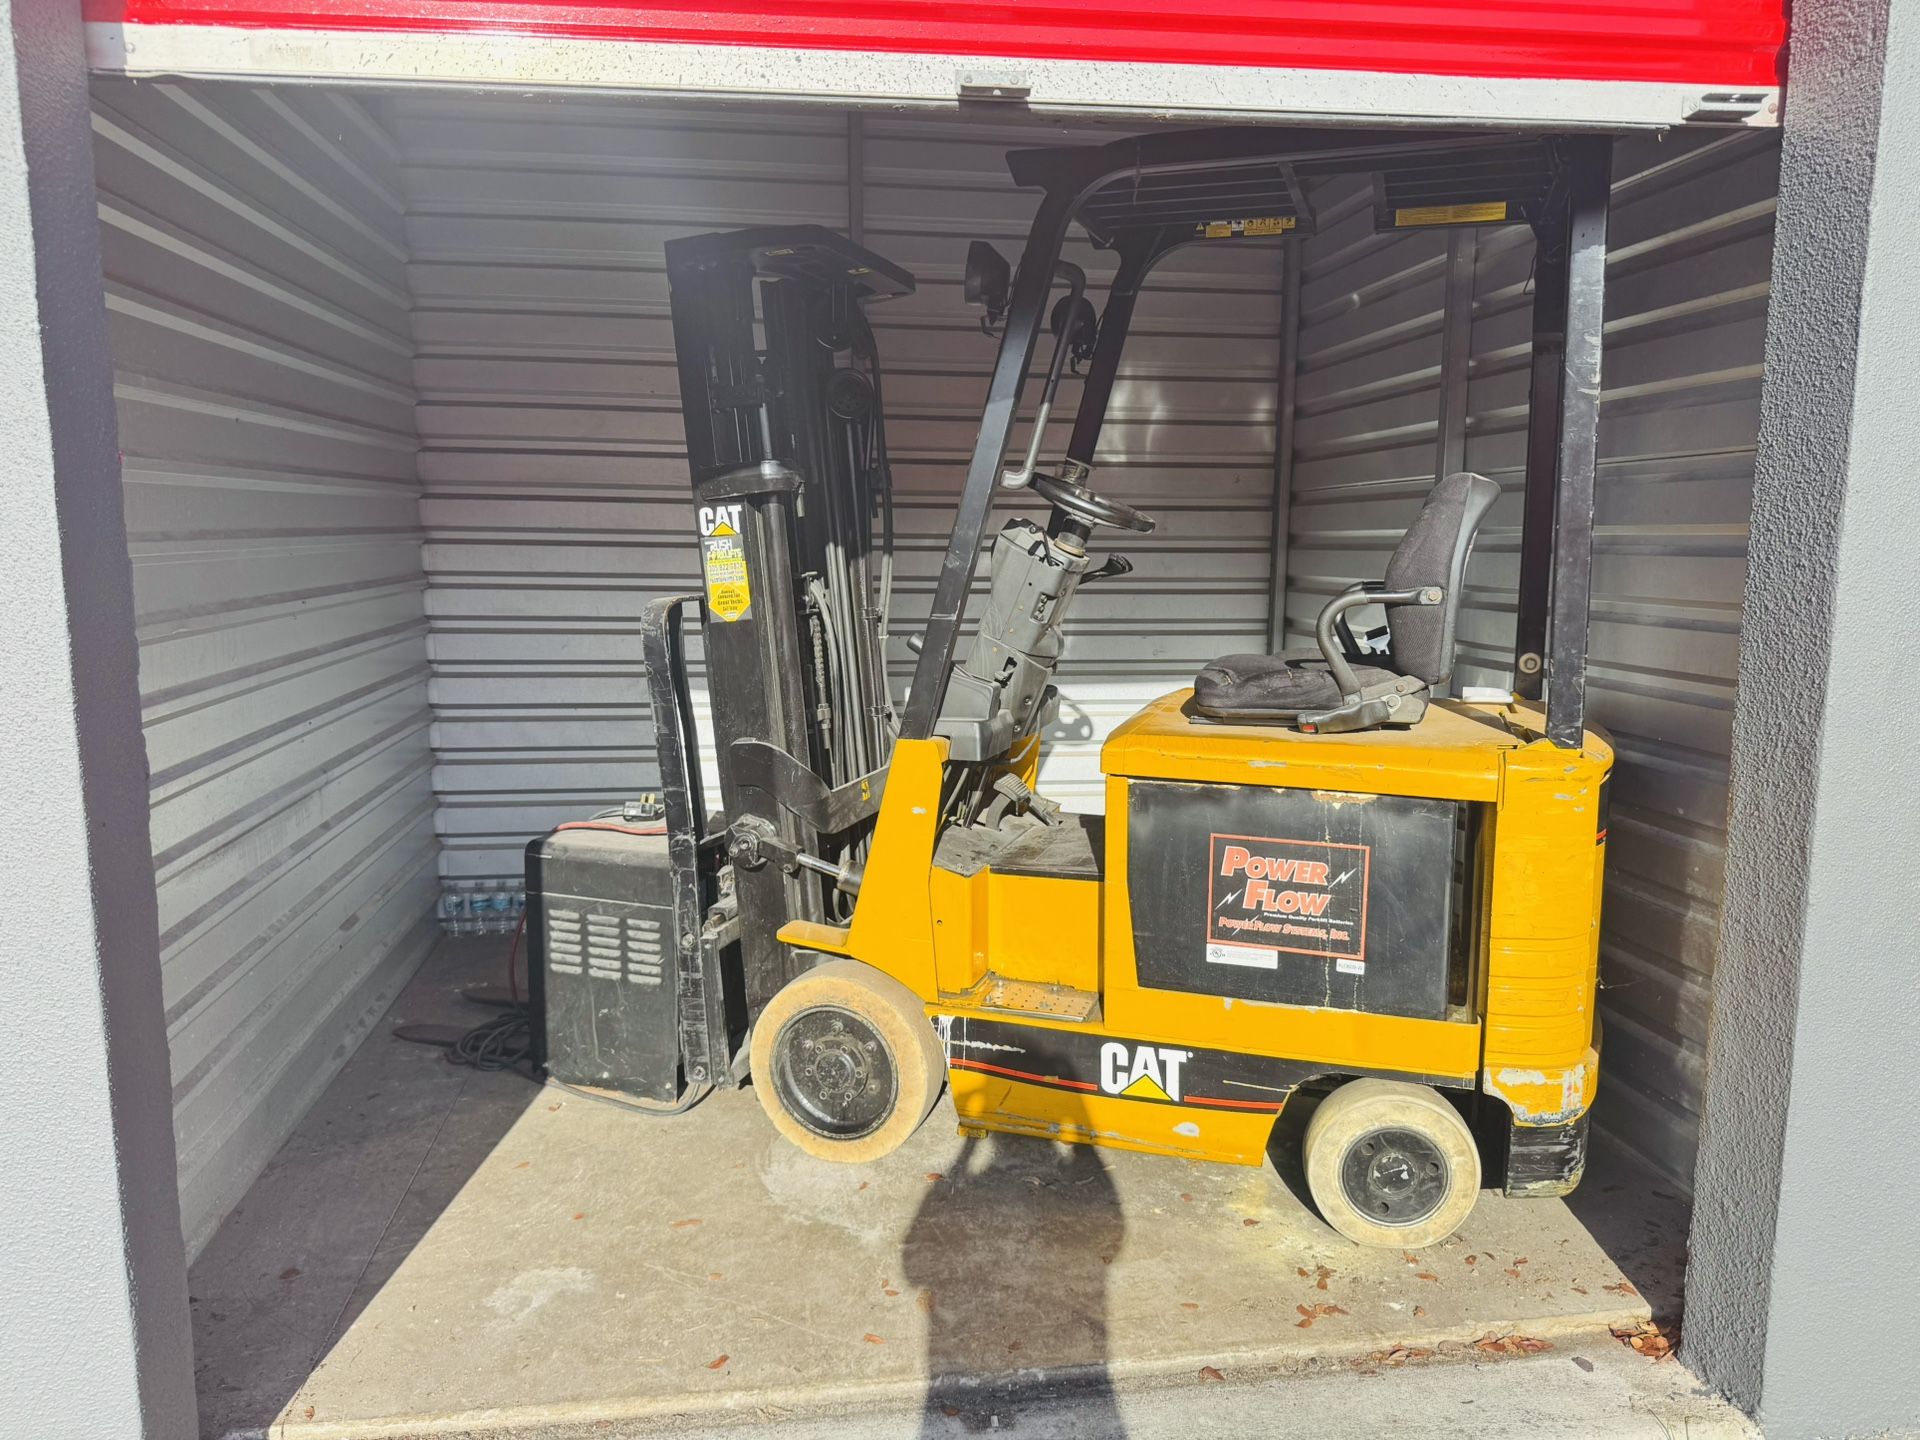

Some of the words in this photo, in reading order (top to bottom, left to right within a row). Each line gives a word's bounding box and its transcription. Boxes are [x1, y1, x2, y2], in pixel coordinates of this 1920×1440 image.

[699, 504, 742, 537] CAT
[1221, 845, 1328, 886] POWER
[1242, 878, 1331, 916] FLOW
[1101, 1042, 1187, 1102] CAT
